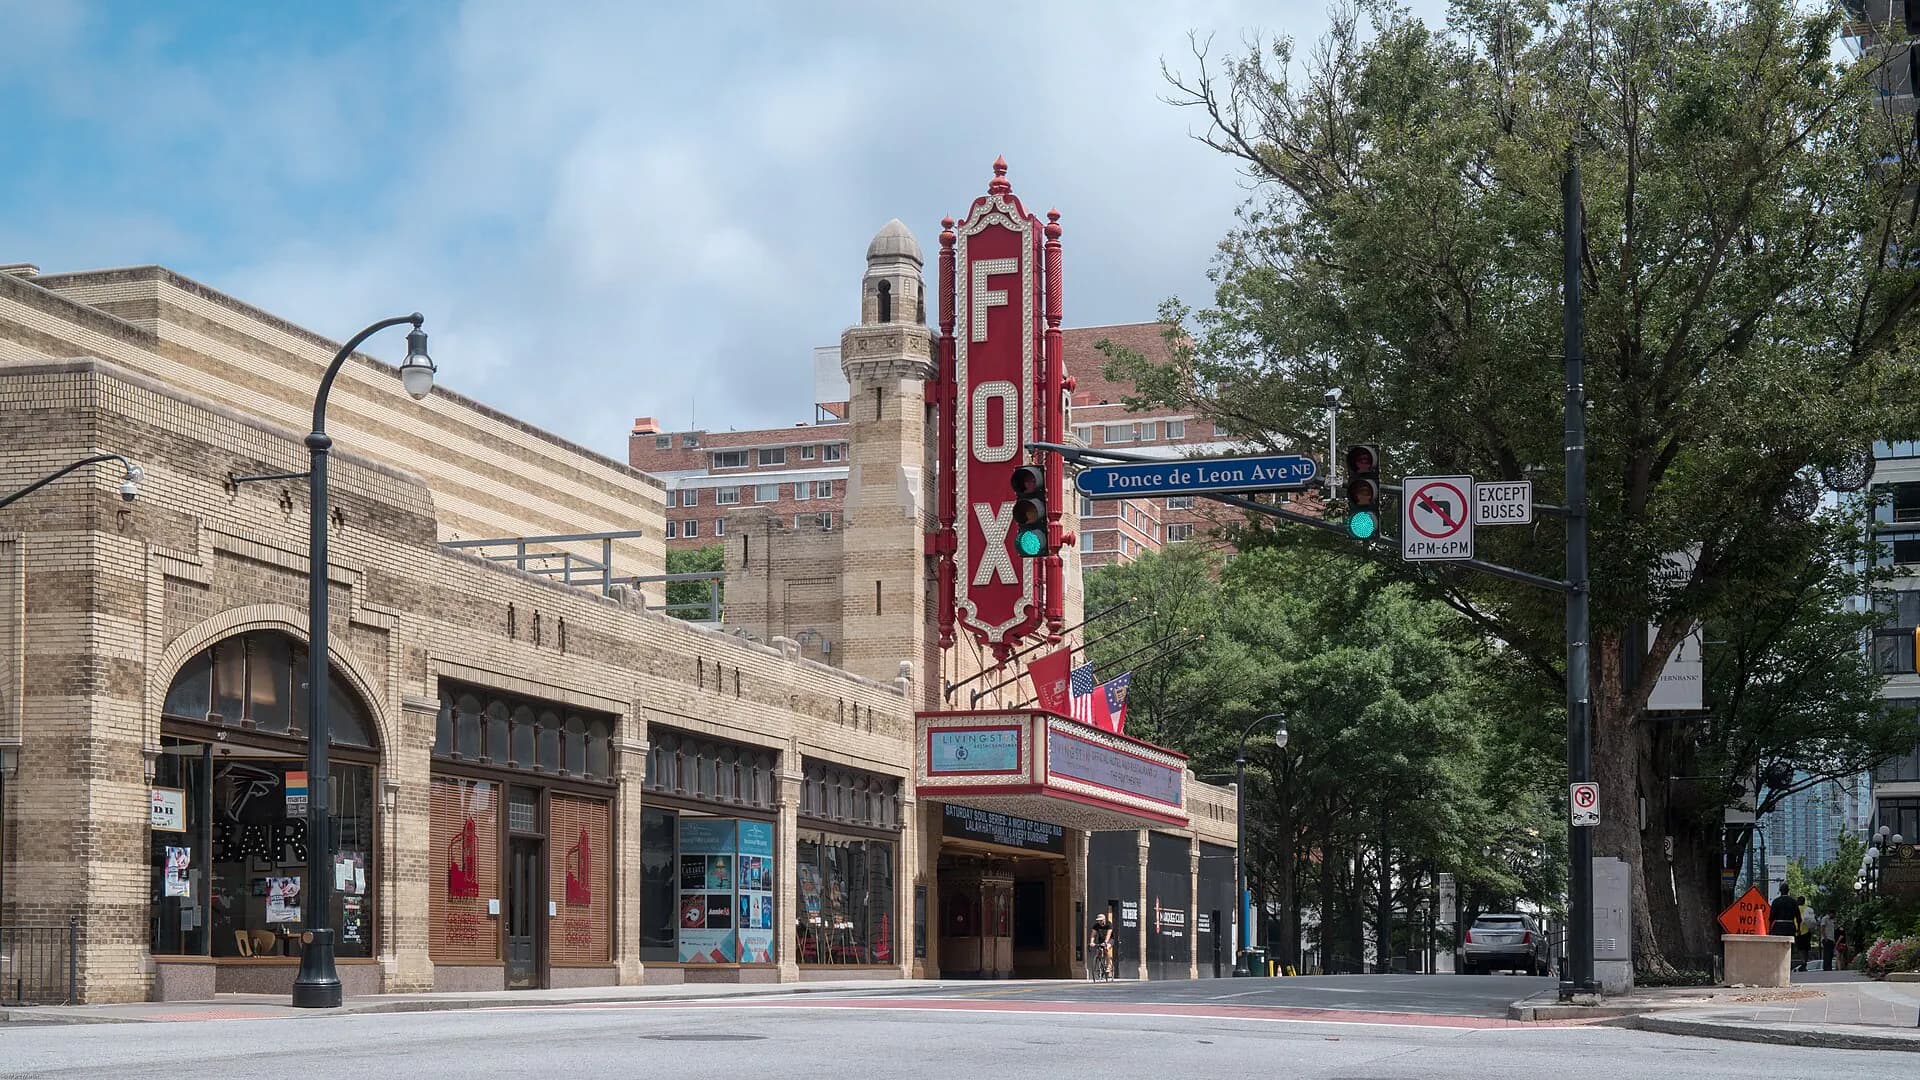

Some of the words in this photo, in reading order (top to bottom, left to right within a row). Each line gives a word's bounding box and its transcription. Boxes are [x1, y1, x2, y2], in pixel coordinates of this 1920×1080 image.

[972, 258, 1019, 586] FOX
[1107, 472, 1162, 488] Ponce
[1169, 468, 1191, 484] de
[1198, 467, 1244, 483] Leon
[1251, 464, 1288, 480] Ave
[1291, 464, 1311, 476] NE
[1479, 486, 1527, 501] EXCEPT
[1482, 504, 1524, 519] BUSES
[1408, 541, 1469, 555] 4PM-6PM
[945, 804, 974, 820] SATURDAY
[974, 810, 988, 822] SOUL
[1740, 902, 1766, 912] ROAD
